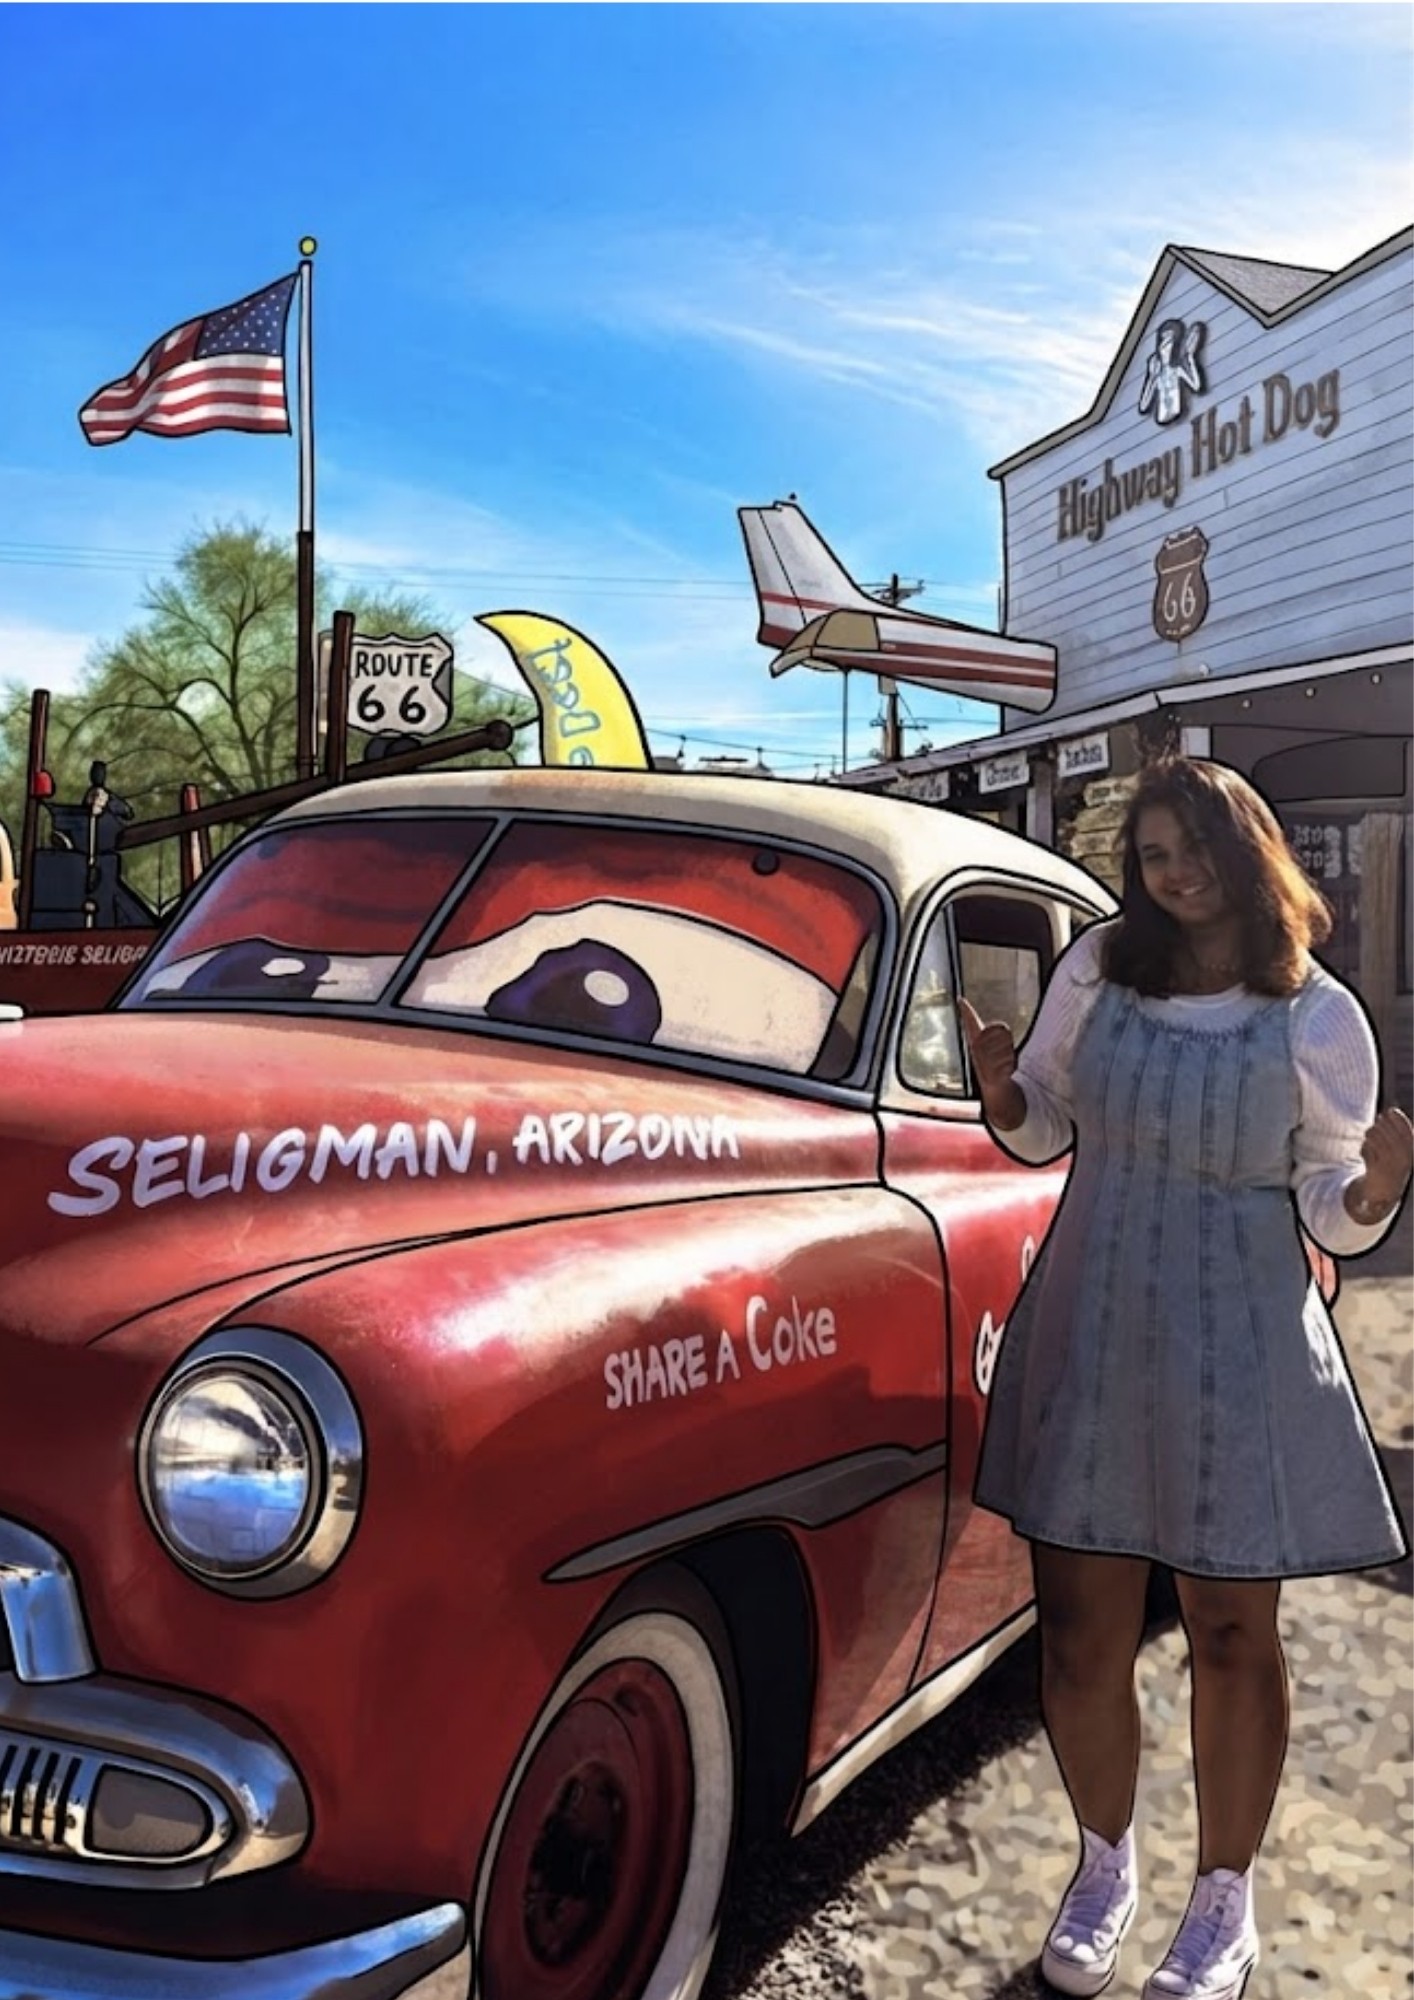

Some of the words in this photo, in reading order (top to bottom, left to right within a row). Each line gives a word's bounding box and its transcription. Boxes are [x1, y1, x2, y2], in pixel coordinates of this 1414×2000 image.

[1057, 444, 1182, 543] Highway
[1190, 394, 1255, 477] Hot
[1262, 369, 1340, 438] Dog
[1163, 571, 1196, 622] 66
[354, 650, 434, 678] ROUTE
[511, 1110, 740, 1167] ARIZONA
[603, 1333, 709, 1409] SHARE
[715, 1328, 741, 1384] A
[746, 1294, 837, 1371] Coke
